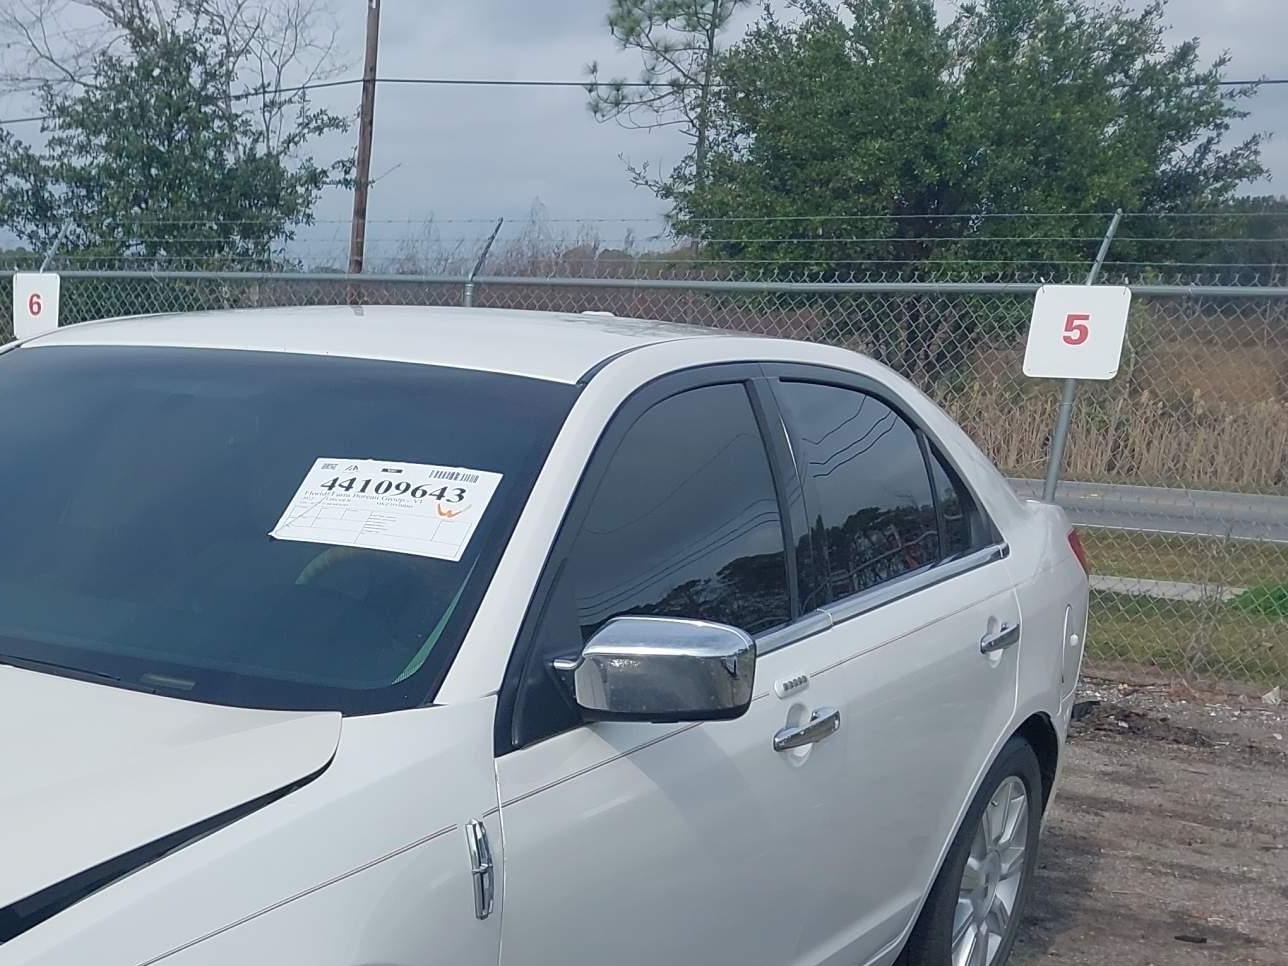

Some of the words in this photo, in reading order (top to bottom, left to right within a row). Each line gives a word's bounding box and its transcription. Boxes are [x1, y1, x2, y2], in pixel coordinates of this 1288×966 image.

[29, 293, 42, 316] 6
[1062, 313, 1090, 345] 5
[320, 476, 467, 503] 44109643
